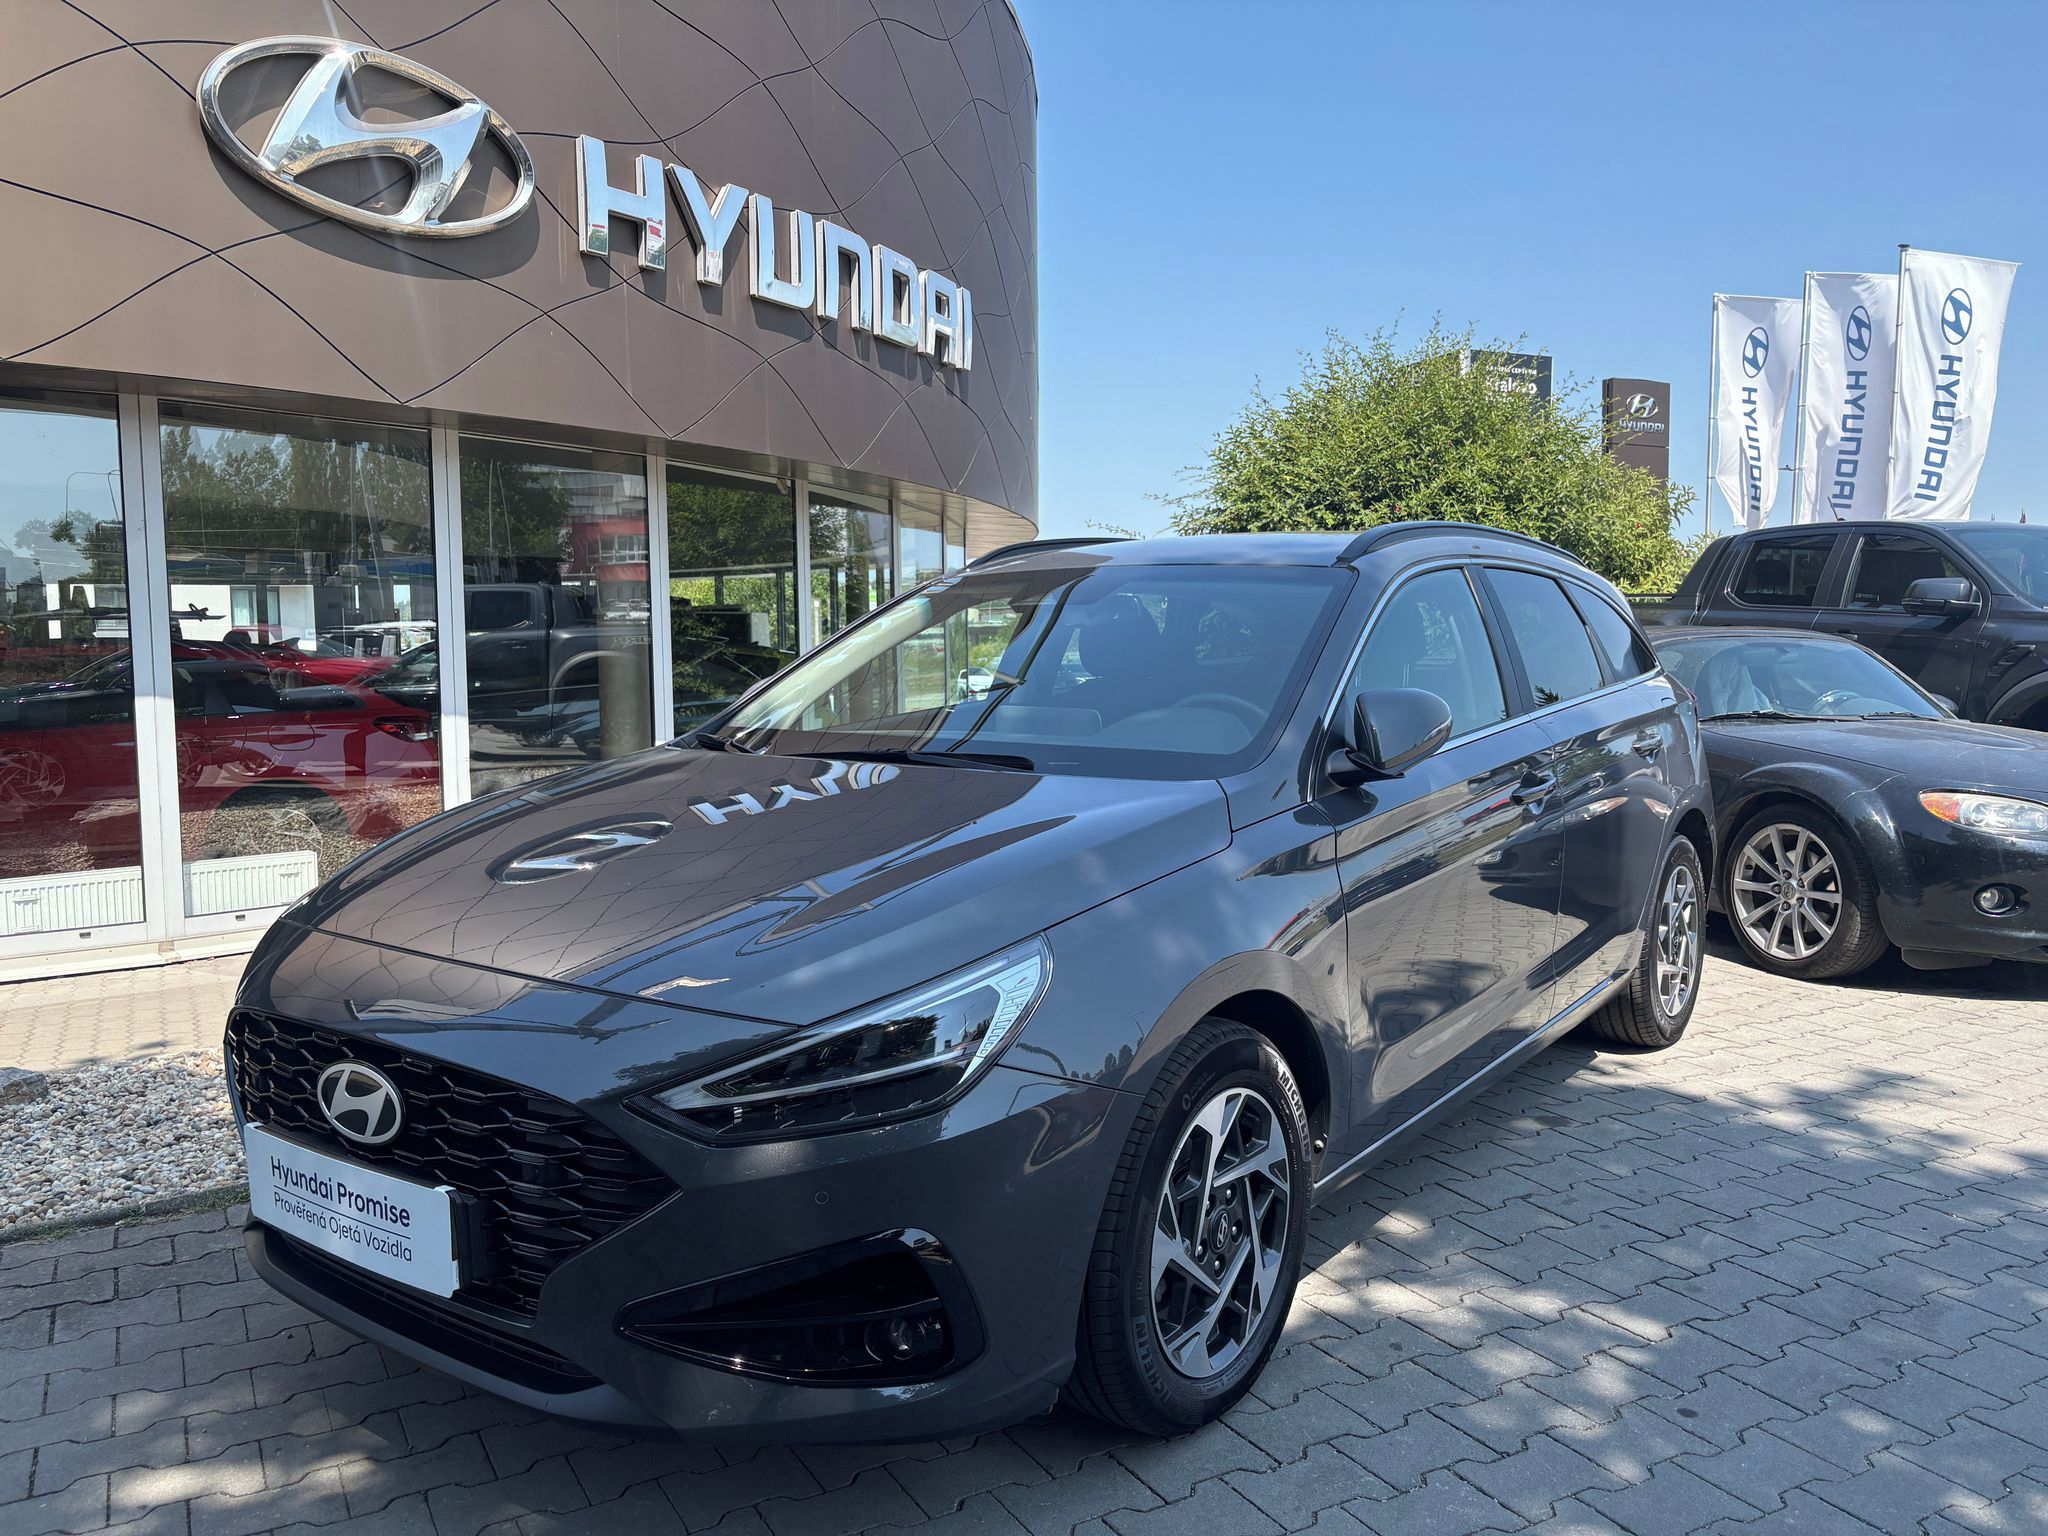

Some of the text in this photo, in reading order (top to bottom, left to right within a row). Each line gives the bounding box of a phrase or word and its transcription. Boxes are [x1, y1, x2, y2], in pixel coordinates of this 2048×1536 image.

[575, 134, 972, 372] HYUNDAI
[1742, 387, 1762, 512] HYUNDAI
[1831, 370, 1868, 509] HYUNDAI
[1914, 354, 1964, 502] HYUNDAI
[1279, 1070, 1310, 1157] MICHELIN
[271, 1155, 410, 1228] Hyundai Promise
[274, 1191, 412, 1262] Prověřená Ojetá Vozidla
